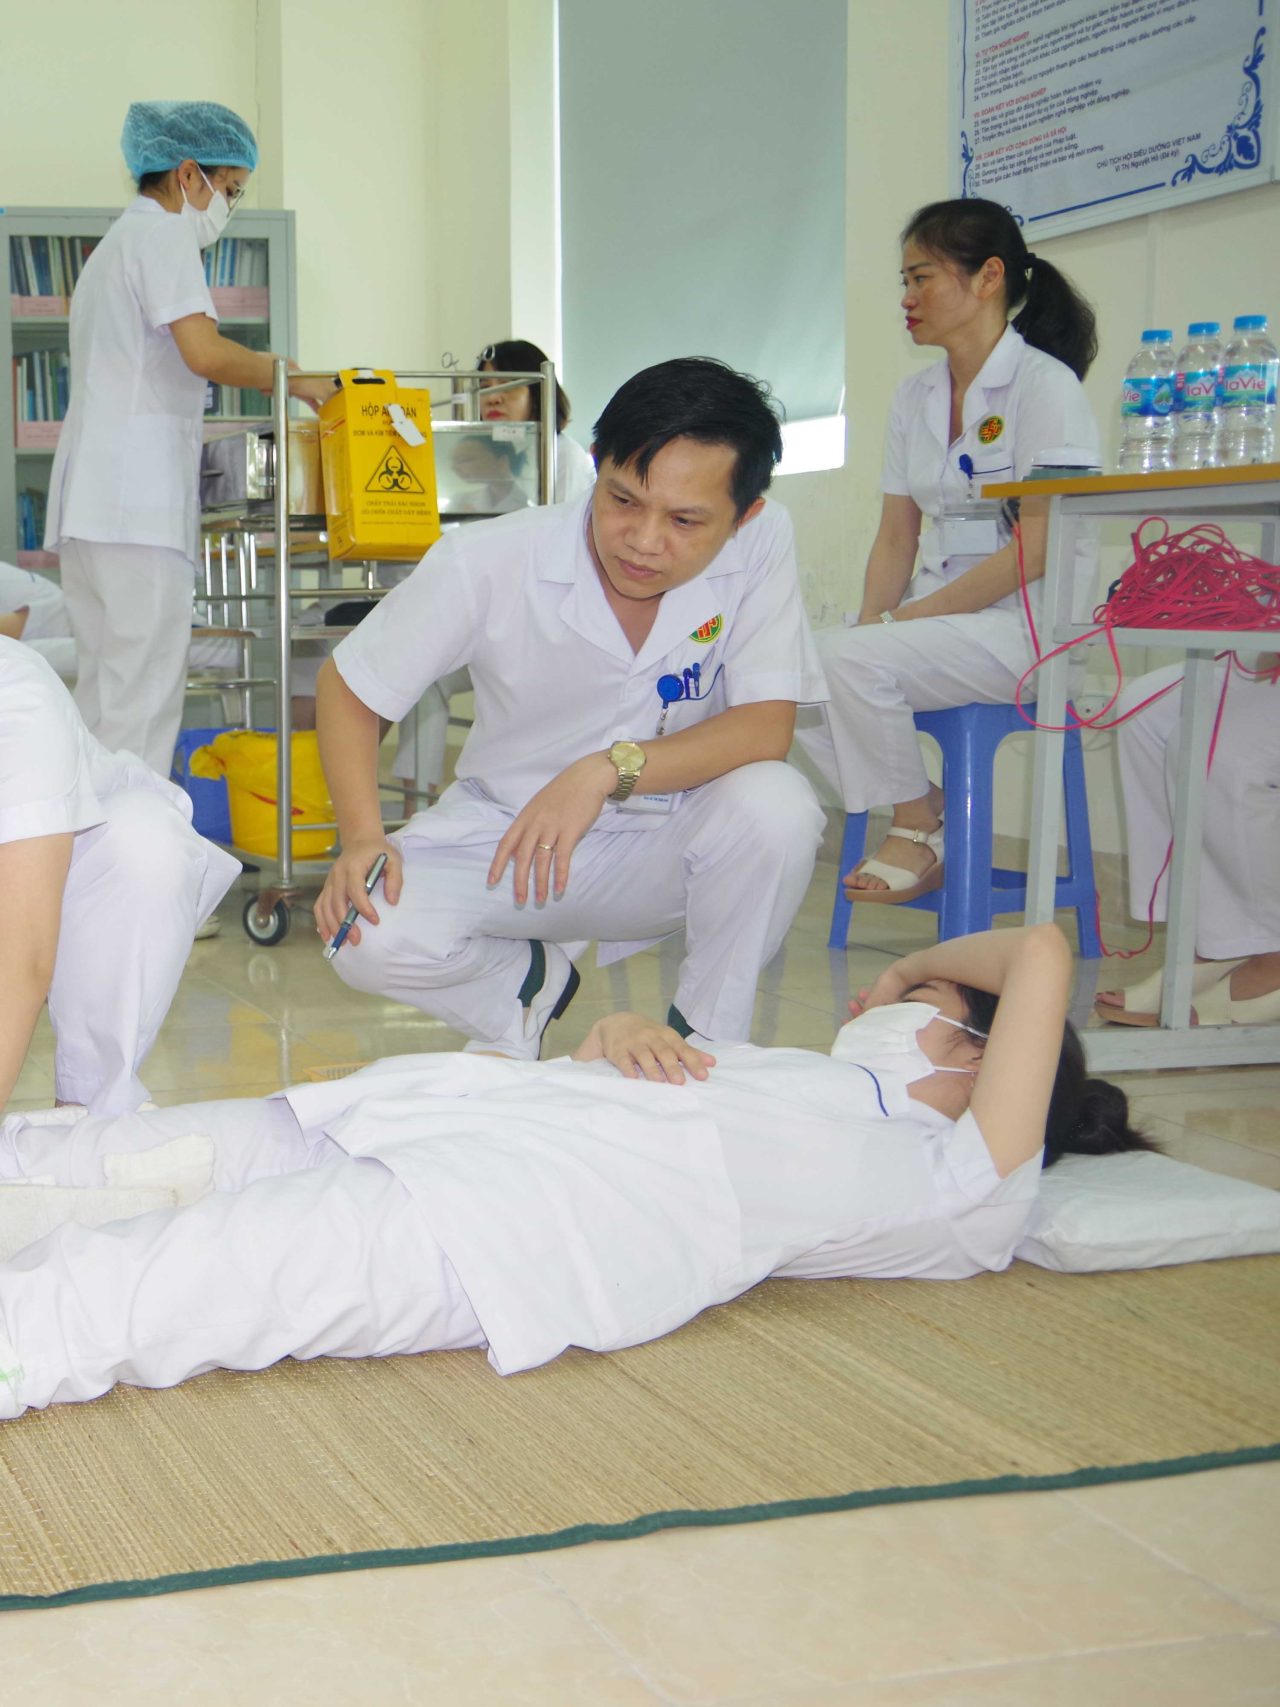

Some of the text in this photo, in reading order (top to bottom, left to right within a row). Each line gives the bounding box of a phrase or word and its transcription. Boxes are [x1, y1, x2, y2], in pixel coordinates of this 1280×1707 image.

[1186, 382, 1216, 397] laV
[1225, 376, 1267, 391] laVie
[361, 403, 380, 419] HỘP
